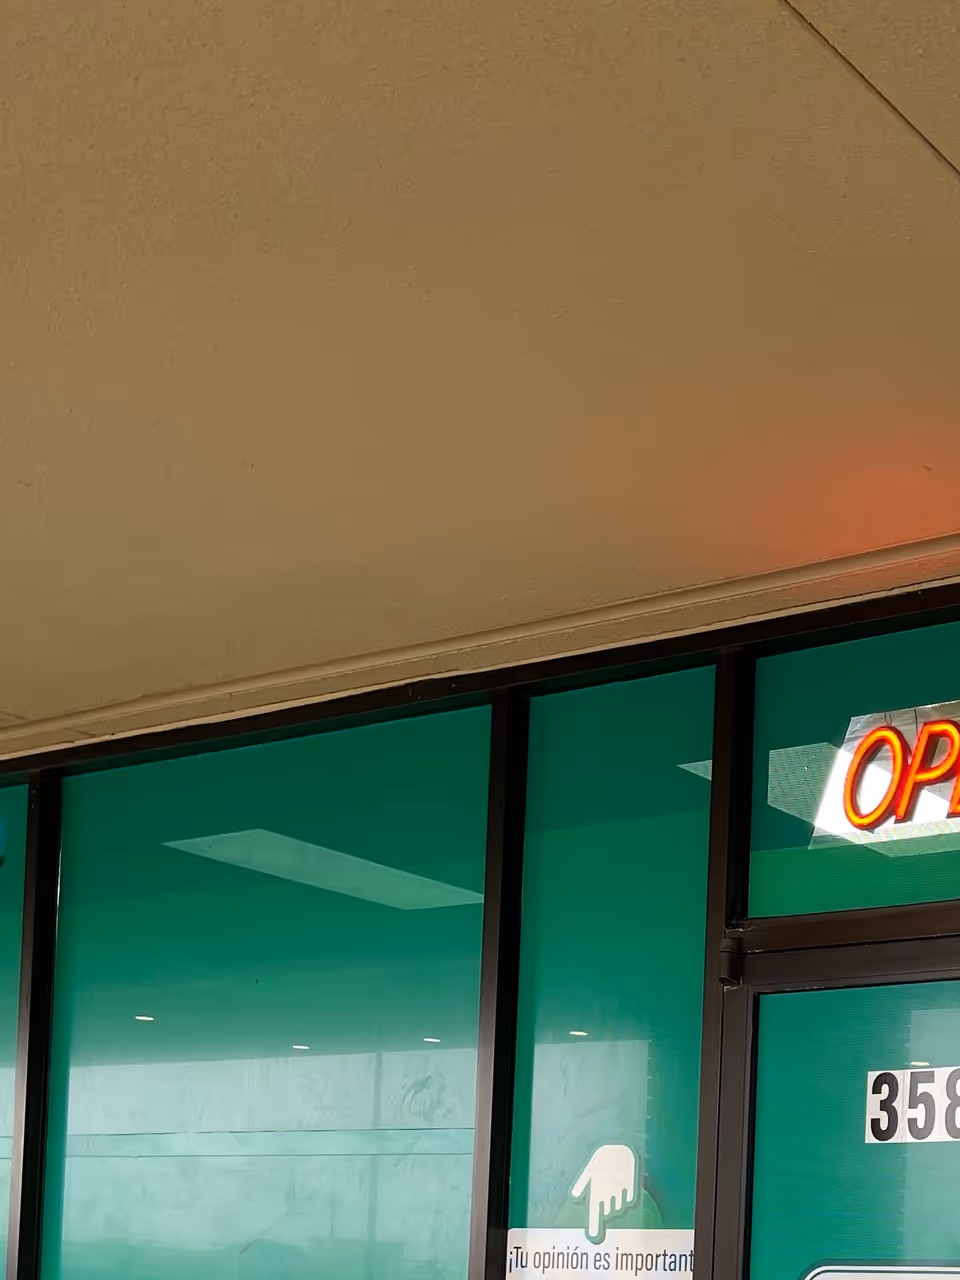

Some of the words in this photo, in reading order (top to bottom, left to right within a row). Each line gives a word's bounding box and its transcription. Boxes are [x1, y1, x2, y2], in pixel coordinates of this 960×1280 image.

[509, 1246, 528, 1273] ¡Tu
[533, 1246, 589, 1274] opinión
[593, 1252, 610, 1271] es
